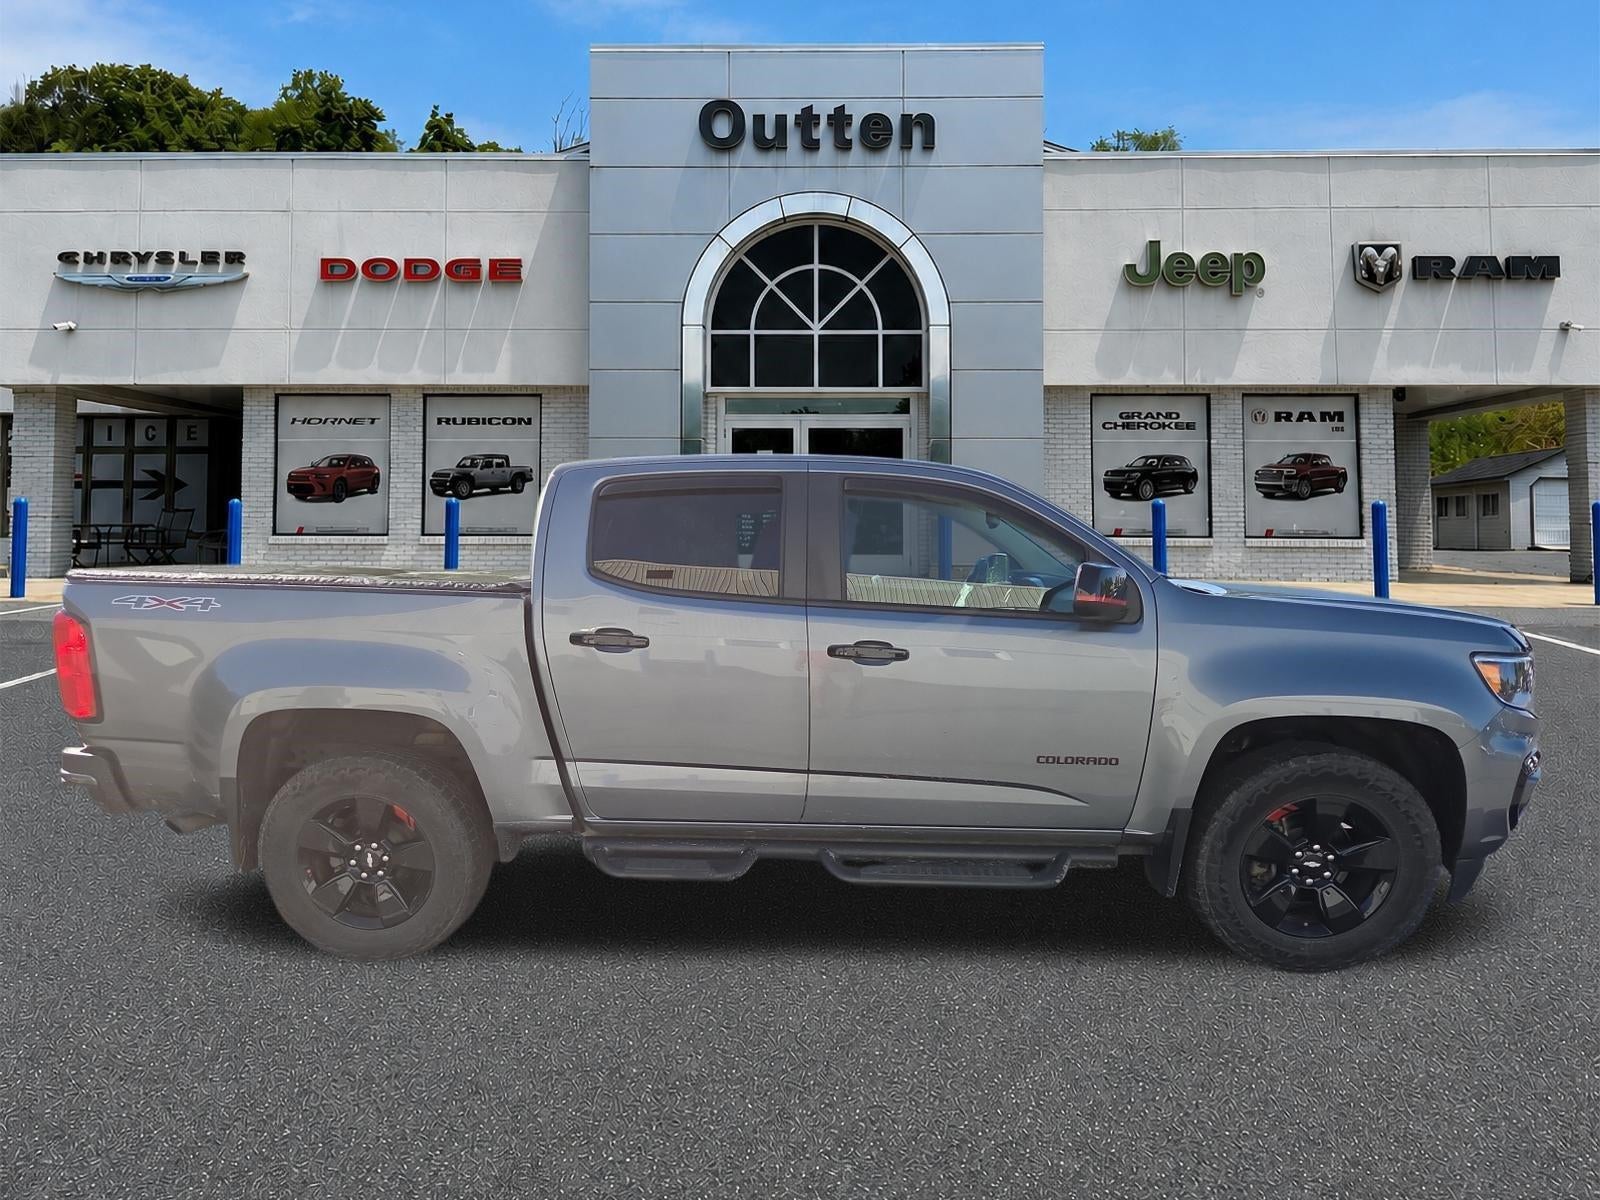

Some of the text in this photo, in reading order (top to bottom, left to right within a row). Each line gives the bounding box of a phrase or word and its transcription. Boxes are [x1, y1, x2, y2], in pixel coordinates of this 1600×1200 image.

[699, 99, 936, 150] Outten
[57, 250, 247, 266] CHRYSLER
[319, 256, 524, 283] DODGE
[1123, 240, 1266, 295] Jeep
[1411, 255, 1561, 281] RAM
[290, 417, 381, 426] HORNET
[436, 417, 533, 426] RUBICON
[1118, 411, 1181, 420] GRAND
[1274, 411, 1345, 423] RAM
[1101, 421, 1197, 431] CHEROKEE
[1036, 755, 1120, 766] COLORADO
